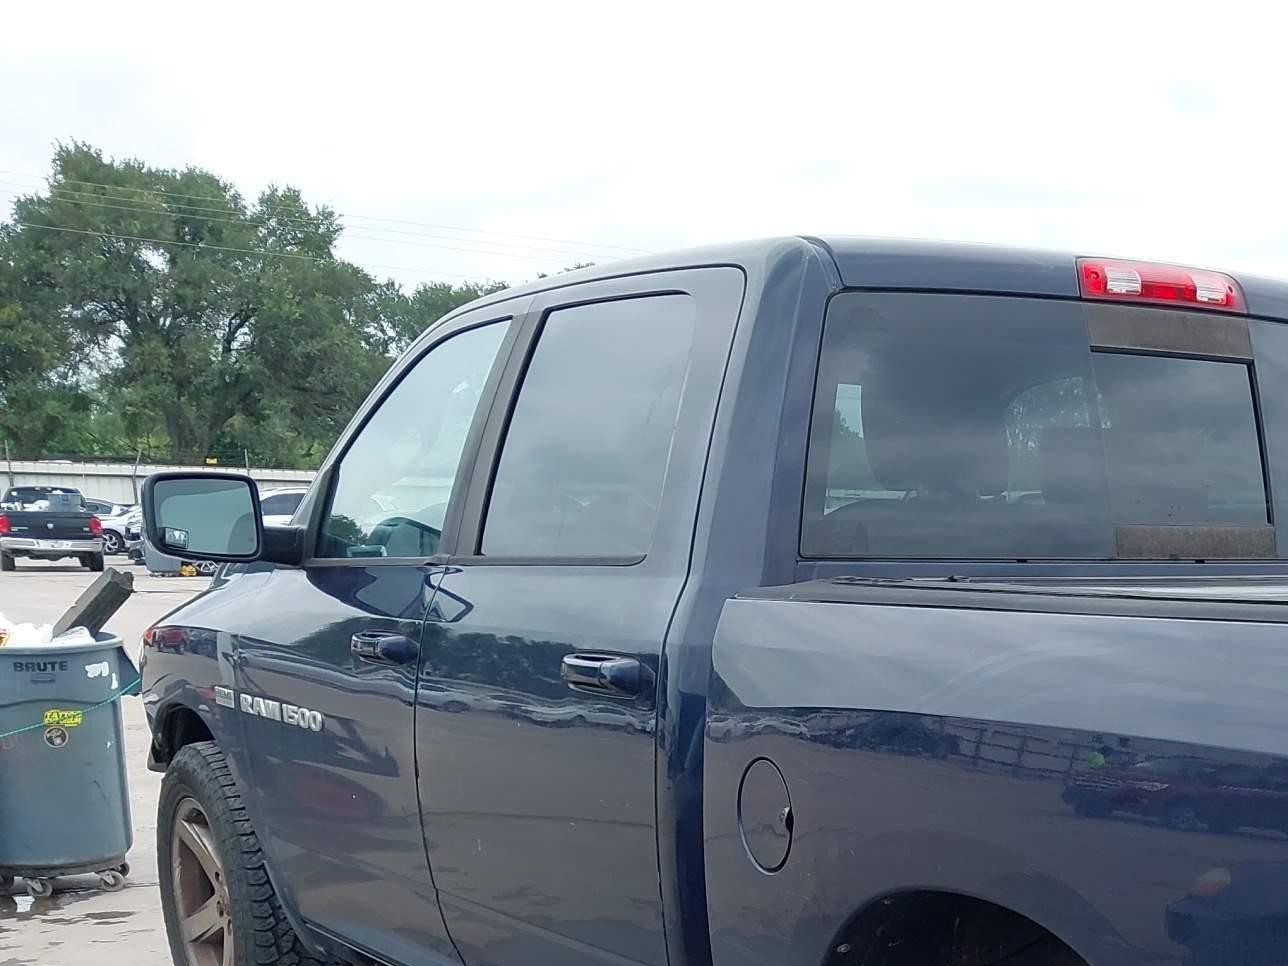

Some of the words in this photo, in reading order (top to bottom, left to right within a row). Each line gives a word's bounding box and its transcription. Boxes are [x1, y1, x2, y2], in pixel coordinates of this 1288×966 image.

[13, 661, 68, 673] BRUTE
[240, 693, 282, 721] RAM
[282, 703, 323, 732] 1500
